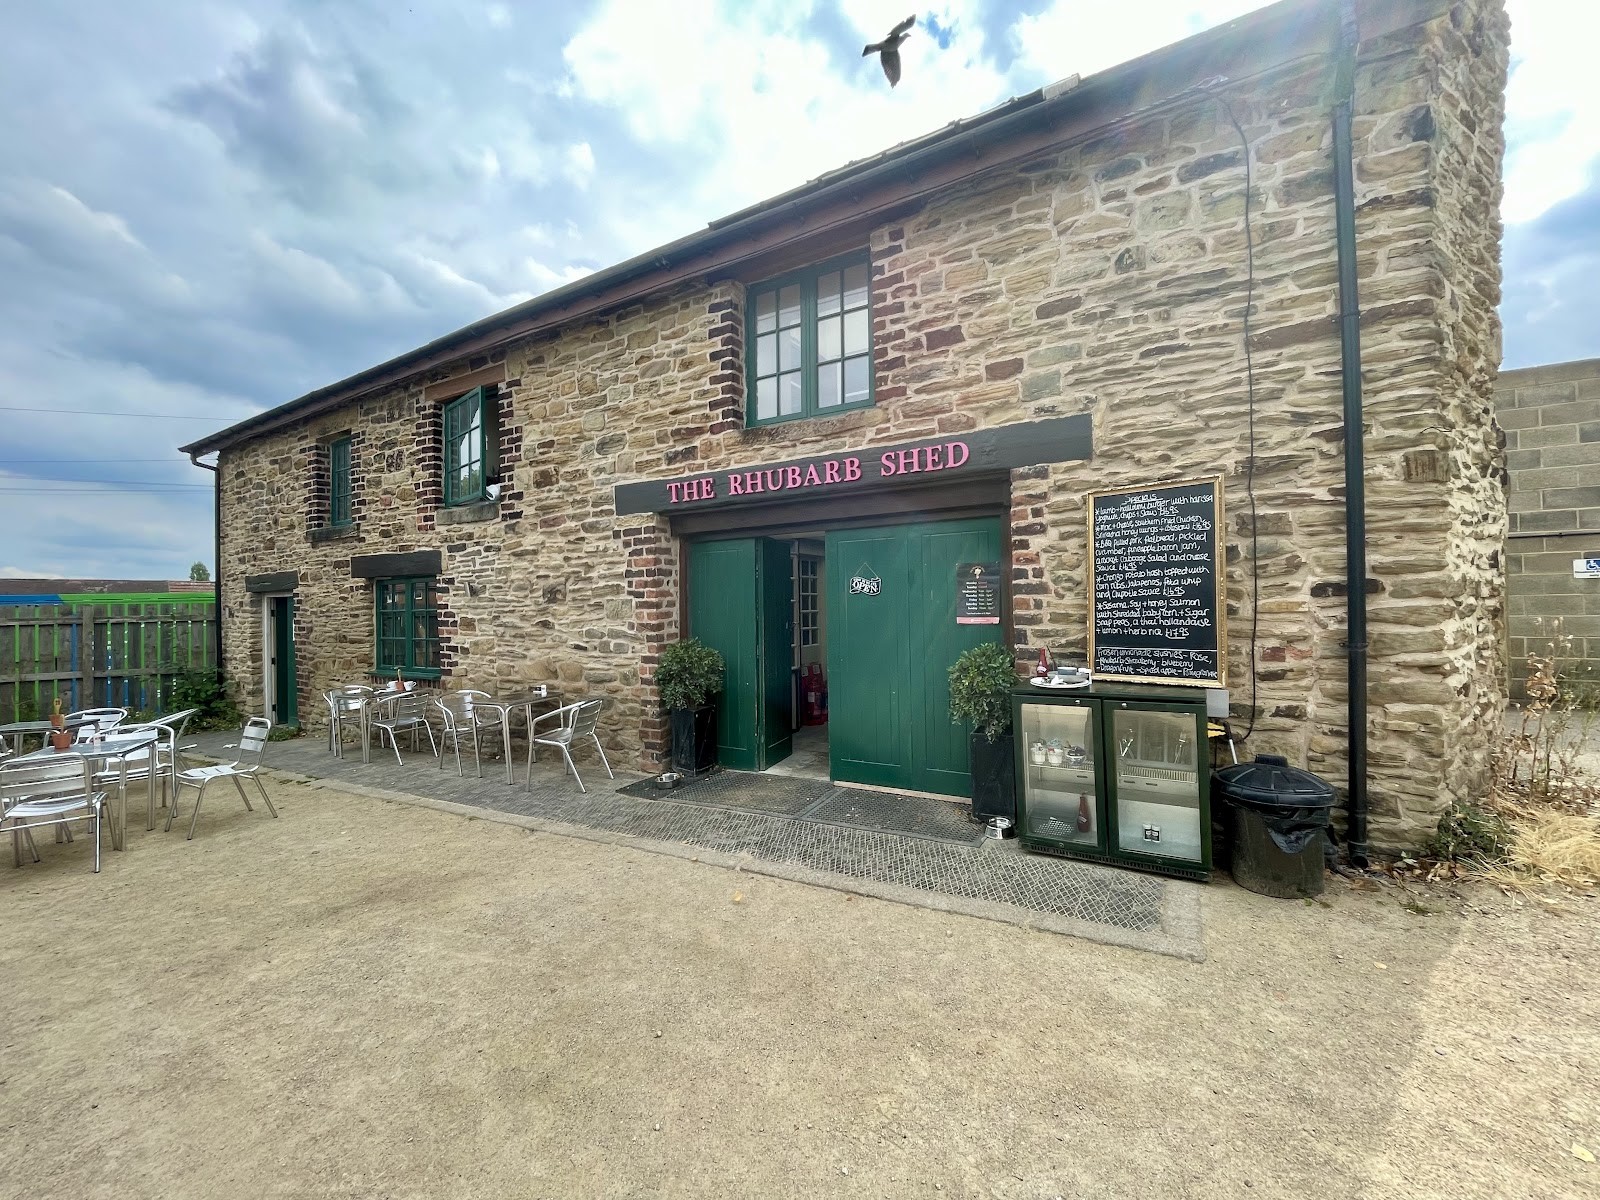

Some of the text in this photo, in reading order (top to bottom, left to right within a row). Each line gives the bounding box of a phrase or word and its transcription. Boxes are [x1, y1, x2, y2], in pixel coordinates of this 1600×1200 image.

[666, 441, 969, 503] THE RHUBARB SHED
[1171, 496, 1188, 505] with
[1190, 494, 1213, 503] harissa
[1121, 529, 1139, 538] honey
[1139, 526, 1159, 535] wings
[1170, 553, 1186, 562] and
[1146, 568, 1164, 577] hash
[1188, 565, 1210, 574] with
[852, 580, 878, 593] OPEN
[1096, 590, 1111, 601] and
[1147, 598, 1168, 611] honey
[1096, 609, 1112, 619] with
[1142, 607, 1161, 620] baby
[1159, 616, 1212, 627] hollandaise
[1129, 627, 1148, 636] herb
